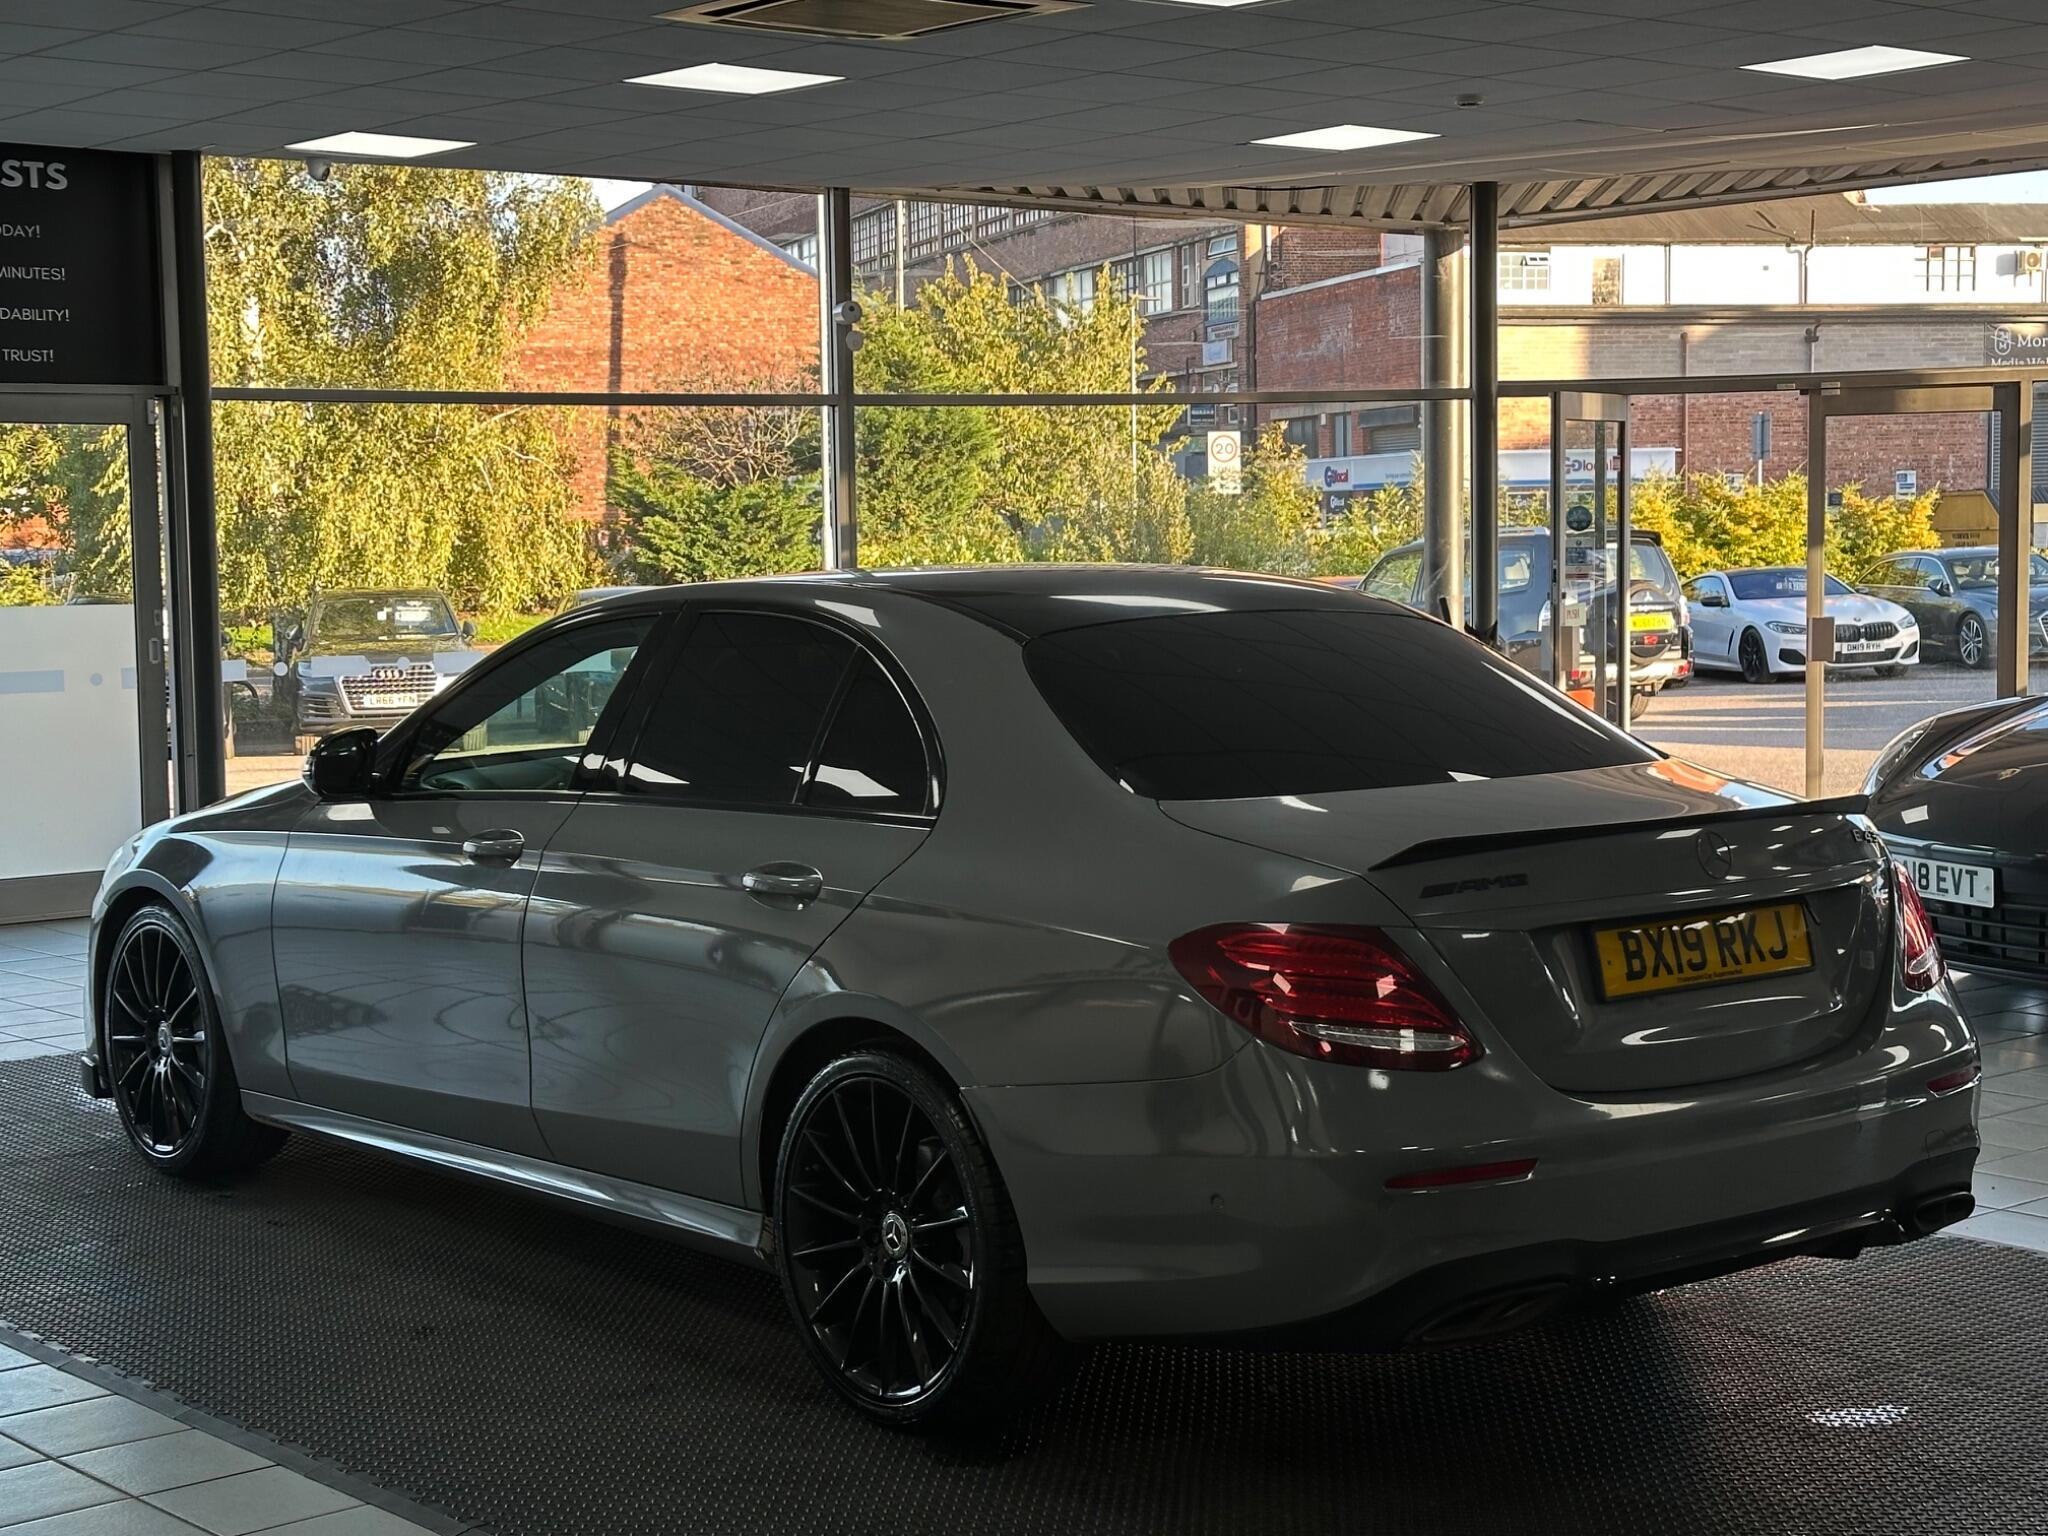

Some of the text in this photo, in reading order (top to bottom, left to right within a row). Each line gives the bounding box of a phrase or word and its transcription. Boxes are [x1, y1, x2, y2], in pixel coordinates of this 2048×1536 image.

[0, 159, 68, 190] STS
[0, 223, 40, 239] DAY!
[1, 347, 54, 362] TRUST!
[1215, 443, 1234, 455] 20
[1935, 865, 1979, 898] EVT
[1617, 909, 1790, 983] BX19 RKJ
